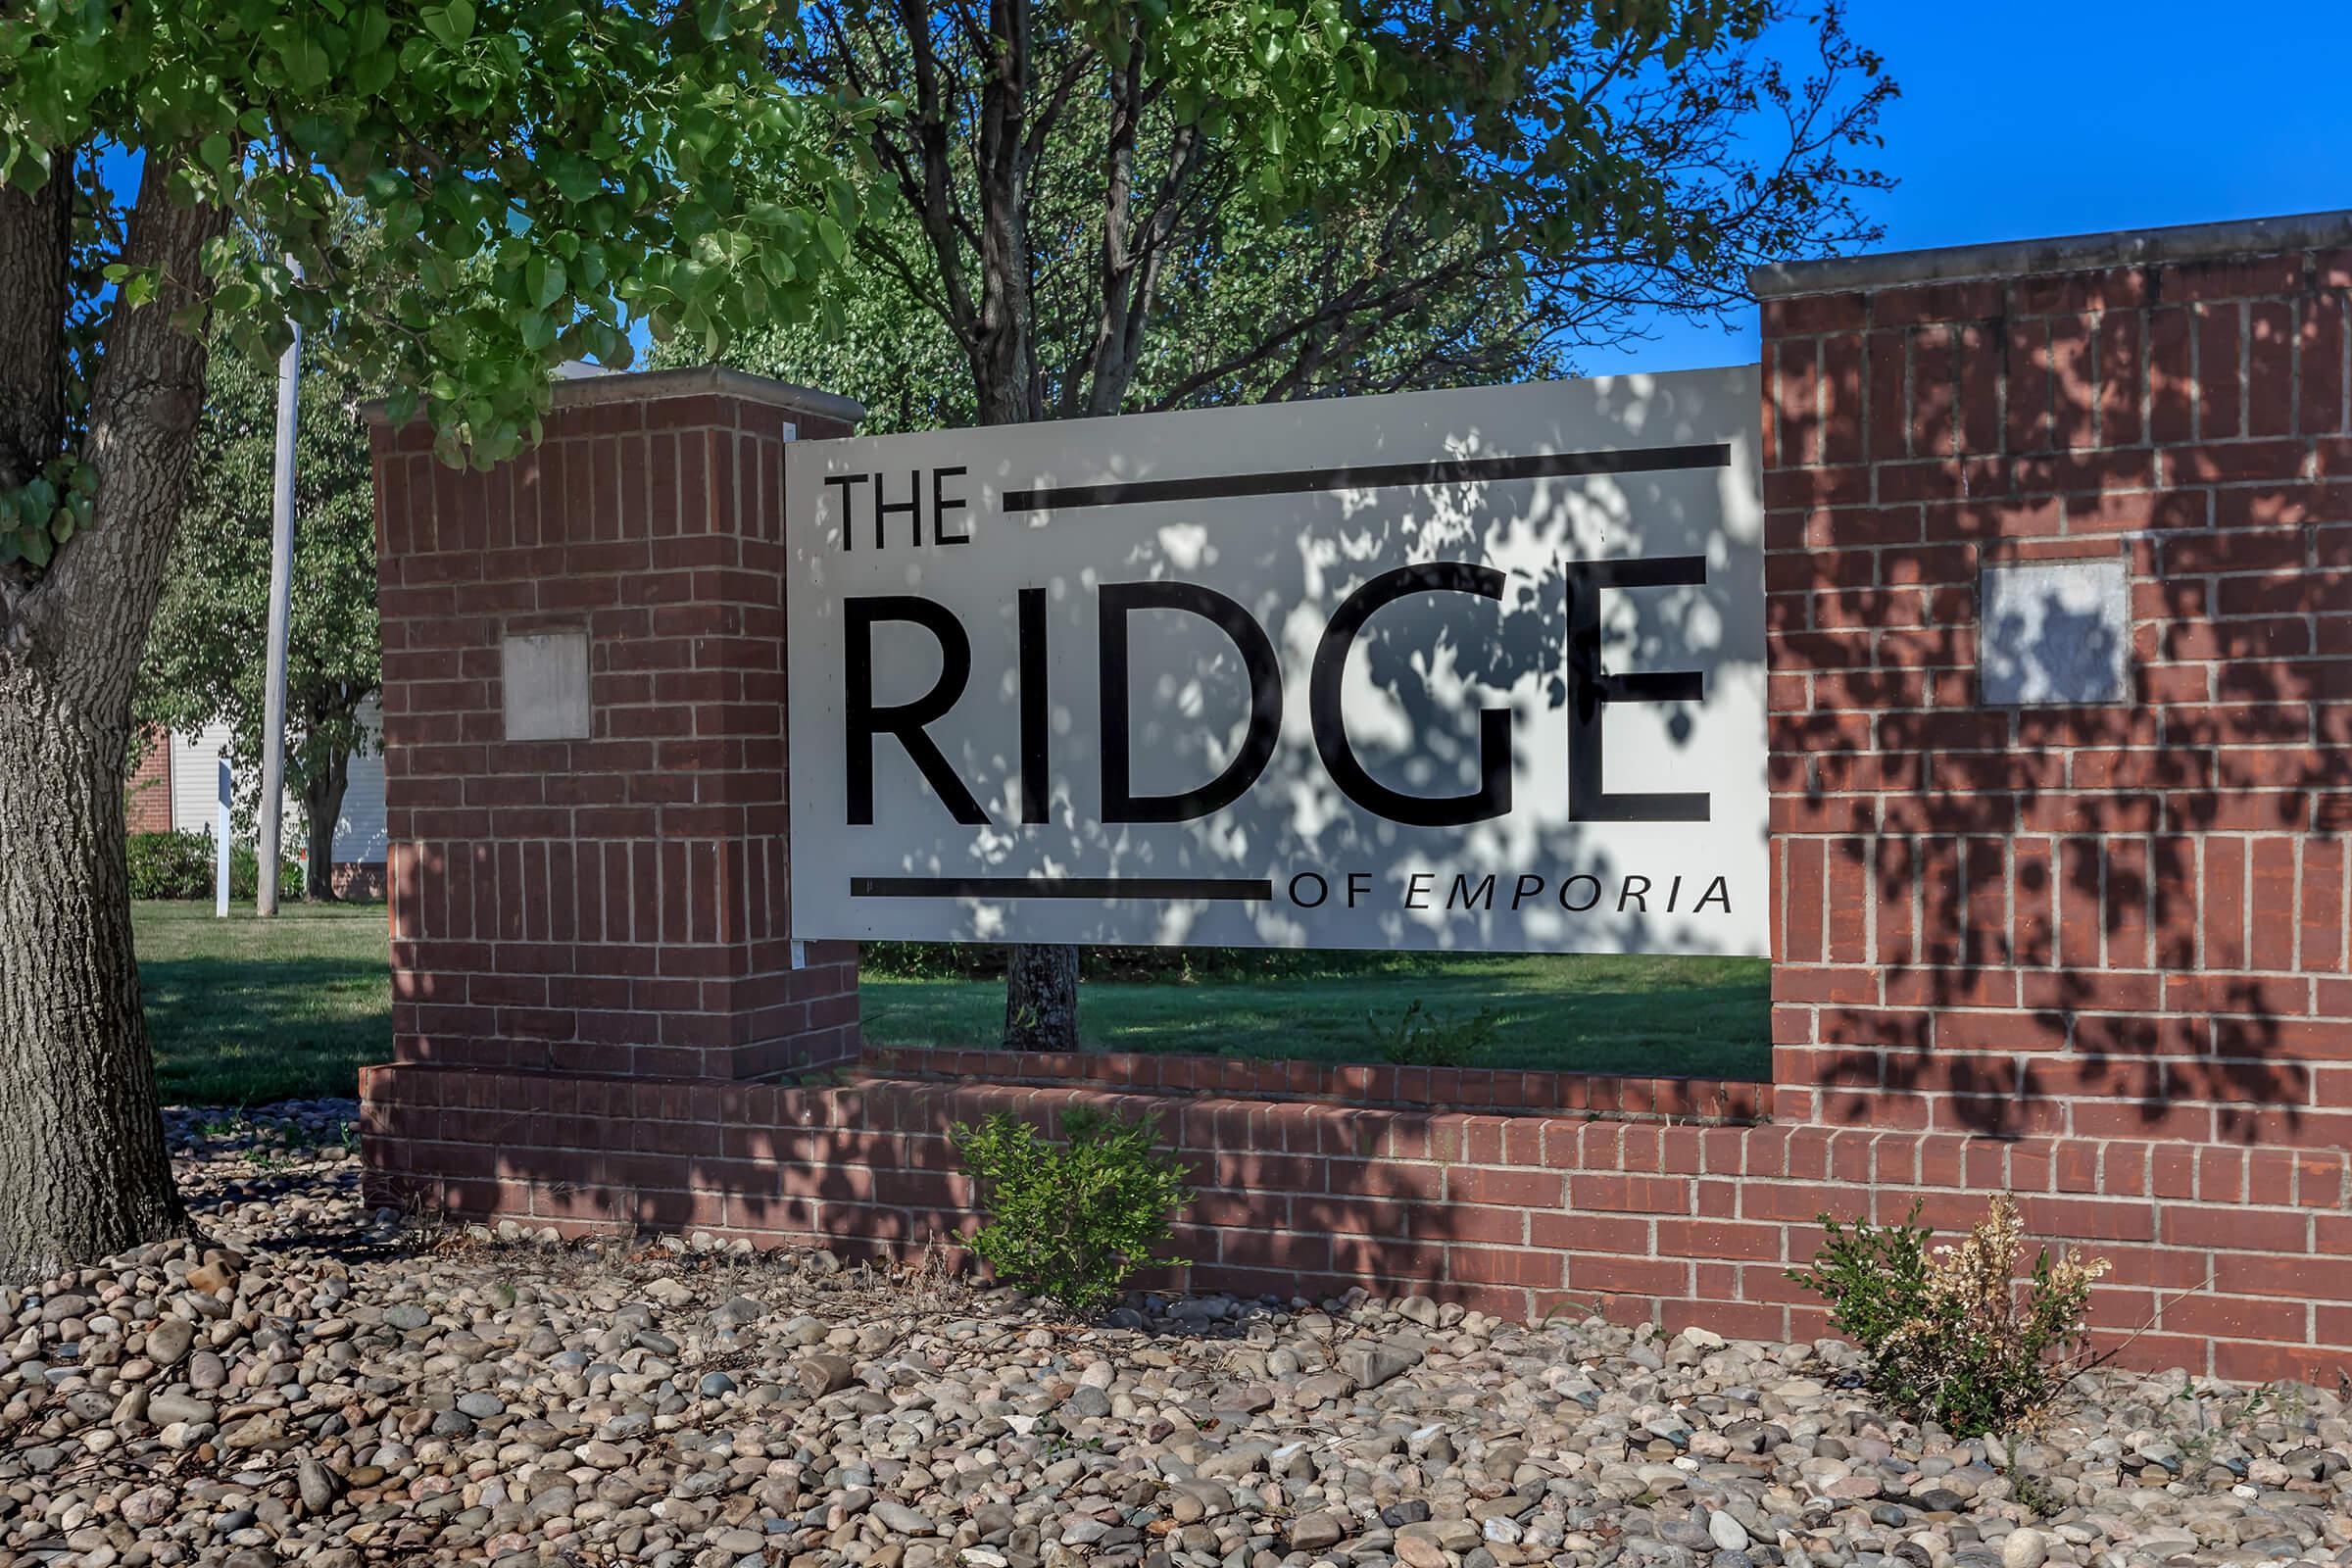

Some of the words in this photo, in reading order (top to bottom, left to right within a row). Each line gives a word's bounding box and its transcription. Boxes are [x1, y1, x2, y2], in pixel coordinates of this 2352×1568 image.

[824, 466, 970, 552] THE
[844, 555, 1711, 827] RIDGE
[1288, 870, 1373, 909] OF
[1404, 871, 1733, 914] EMPORIA
